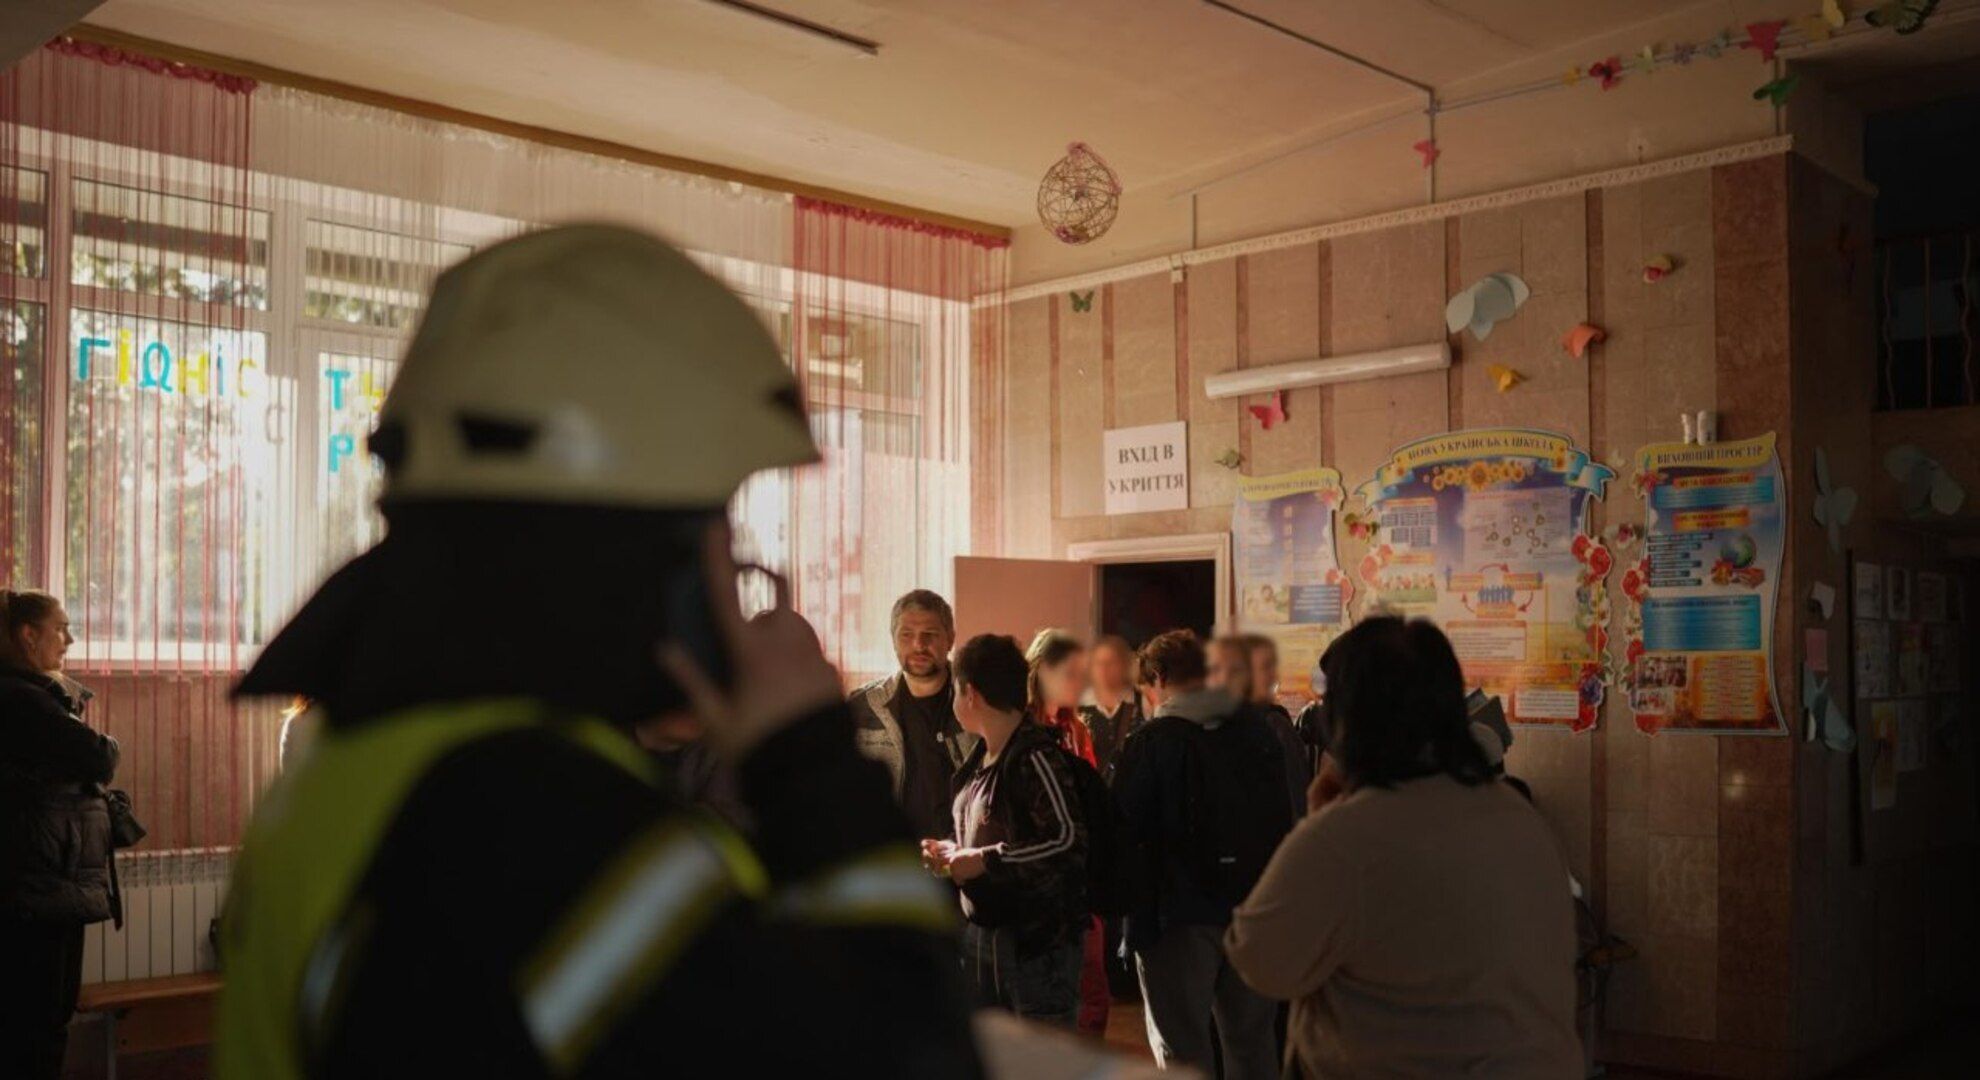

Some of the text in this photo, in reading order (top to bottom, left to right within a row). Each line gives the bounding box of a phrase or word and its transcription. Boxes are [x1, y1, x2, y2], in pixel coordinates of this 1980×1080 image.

[1119, 444, 1174, 464] ВХІД В
[1408, 435, 1554, 460] НОВА УКРАЇНСЬКА ШКОЛА
[1109, 473, 1184, 494] УКРИТТЯ
